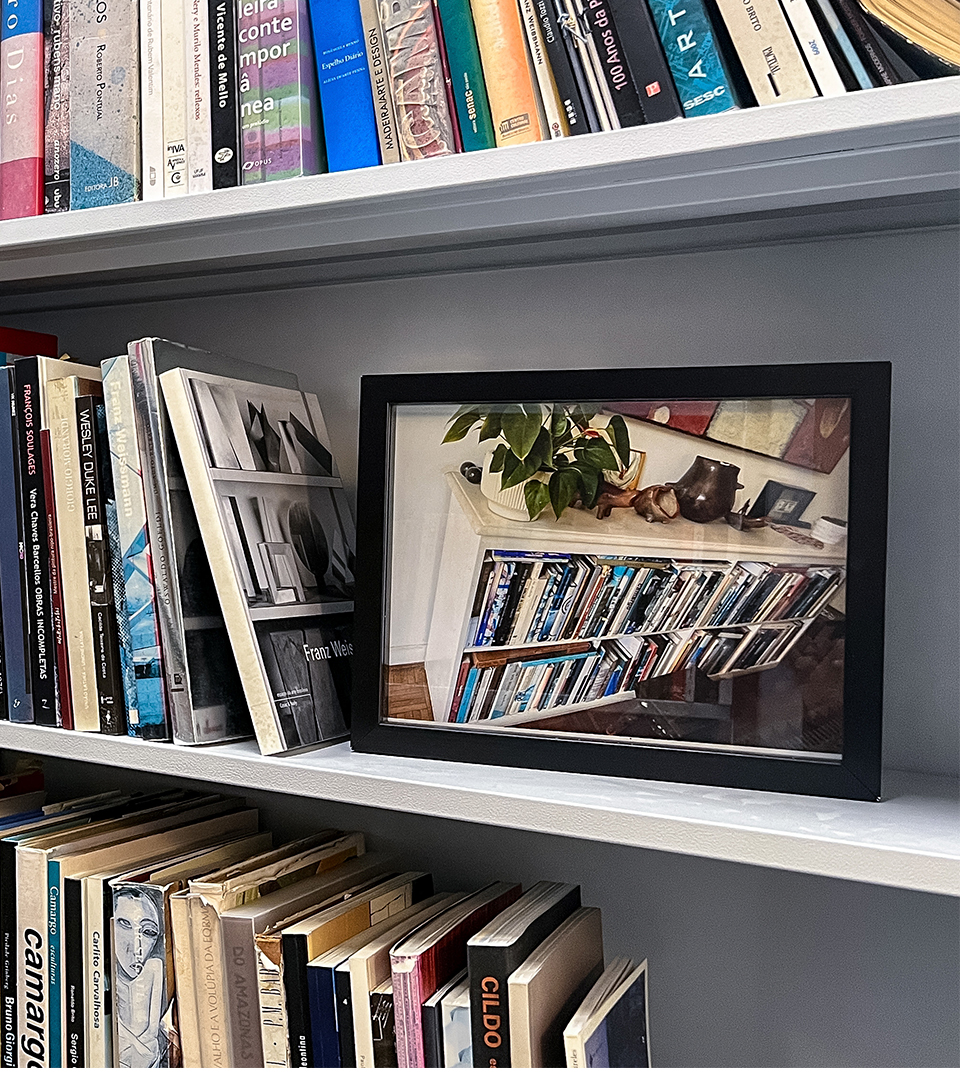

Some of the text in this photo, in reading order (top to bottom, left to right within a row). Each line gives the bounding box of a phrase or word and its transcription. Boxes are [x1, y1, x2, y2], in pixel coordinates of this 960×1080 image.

[193, 23, 201, 52] Murilo
[238, 15, 294, 44] conte
[745, 6, 762, 32] BRITO
[52, 29, 63, 110] rubens mano
[216, 3, 229, 109] Vicente de Mello
[239, 41, 292, 70] mpor
[602, 36, 629, 91] 100 Anos
[6, 48, 25, 126] Dias
[96, 44, 107, 121] ROBERTO PONTUAL
[240, 73, 251, 94] â
[368, 27, 394, 150] MADEIRA/ARTE DESIGN
[466, 89, 477, 121] senac
[683, 85, 726, 110] SESC
[240, 97, 275, 118] nea
[108, 176, 120, 188] JB
[254, 157, 273, 167] OPUS
[53, 188, 63, 208] ubu
[22, 383, 36, 476] FRANÇOIS SOULAGES
[79, 408, 98, 521] WESLEY DUKE LEE
[29, 488, 48, 680] Vera Chaves Barcellos OBRAS INCOMPLETAS
[302, 643, 332, 662] Franz
[47, 885, 59, 986] Camargo esculturas
[92, 931, 104, 1030] Carlito Carvalhosa
[204, 964, 218, 1010] VOLÚPIA
[3, 995, 16, 1069] Bruno Giorgi
[480, 976, 502, 1049] CILDO
[70, 1033, 79, 1064] Sergio
